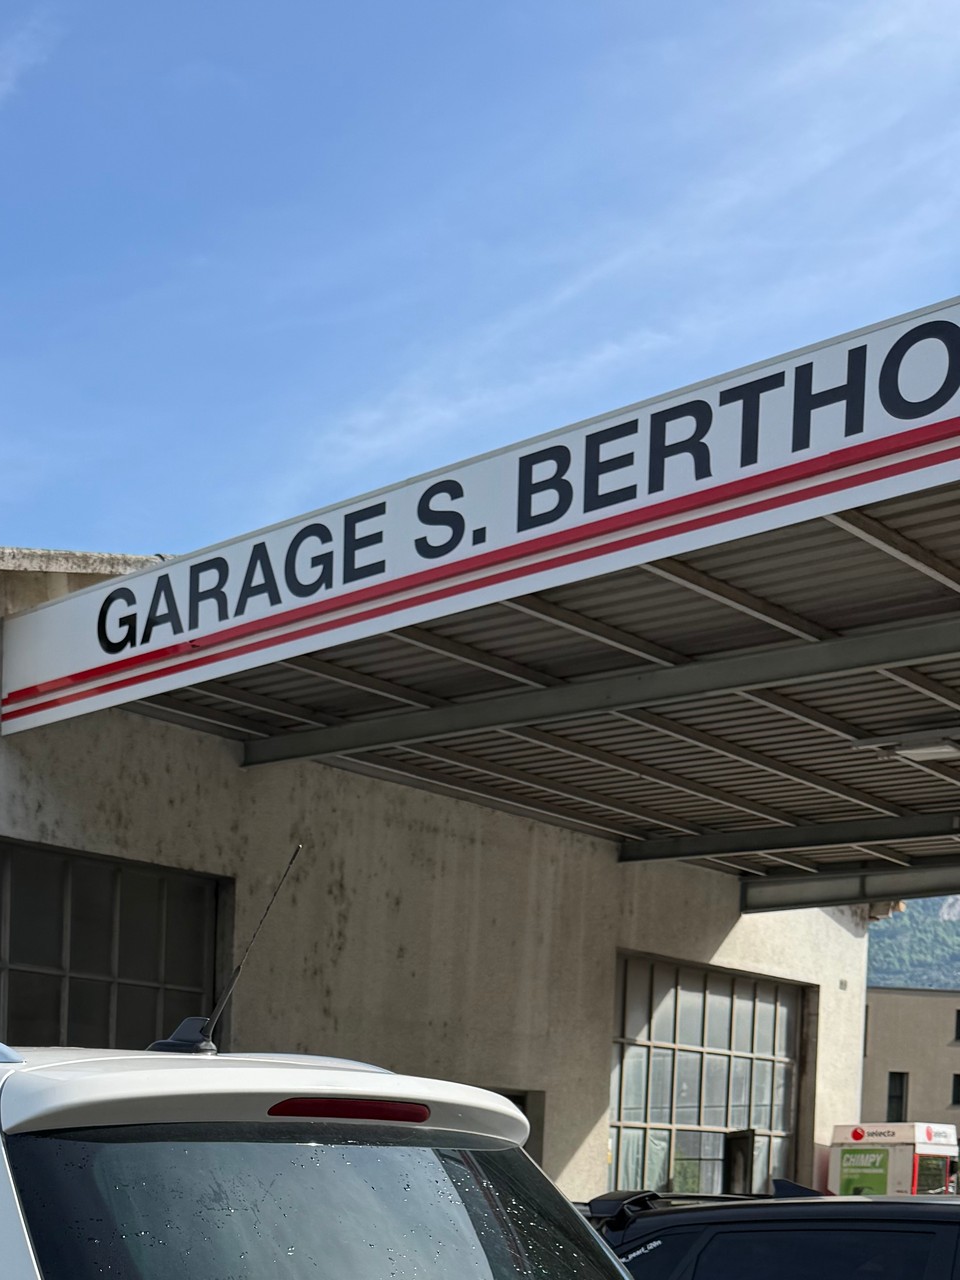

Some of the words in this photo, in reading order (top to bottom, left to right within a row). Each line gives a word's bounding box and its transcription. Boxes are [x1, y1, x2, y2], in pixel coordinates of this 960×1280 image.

[98, 502, 385, 654] GARAGE
[415, 480, 487, 558] S.
[517, 321, 960, 533] BERTHO
[842, 1153, 883, 1167] CHIMPY
